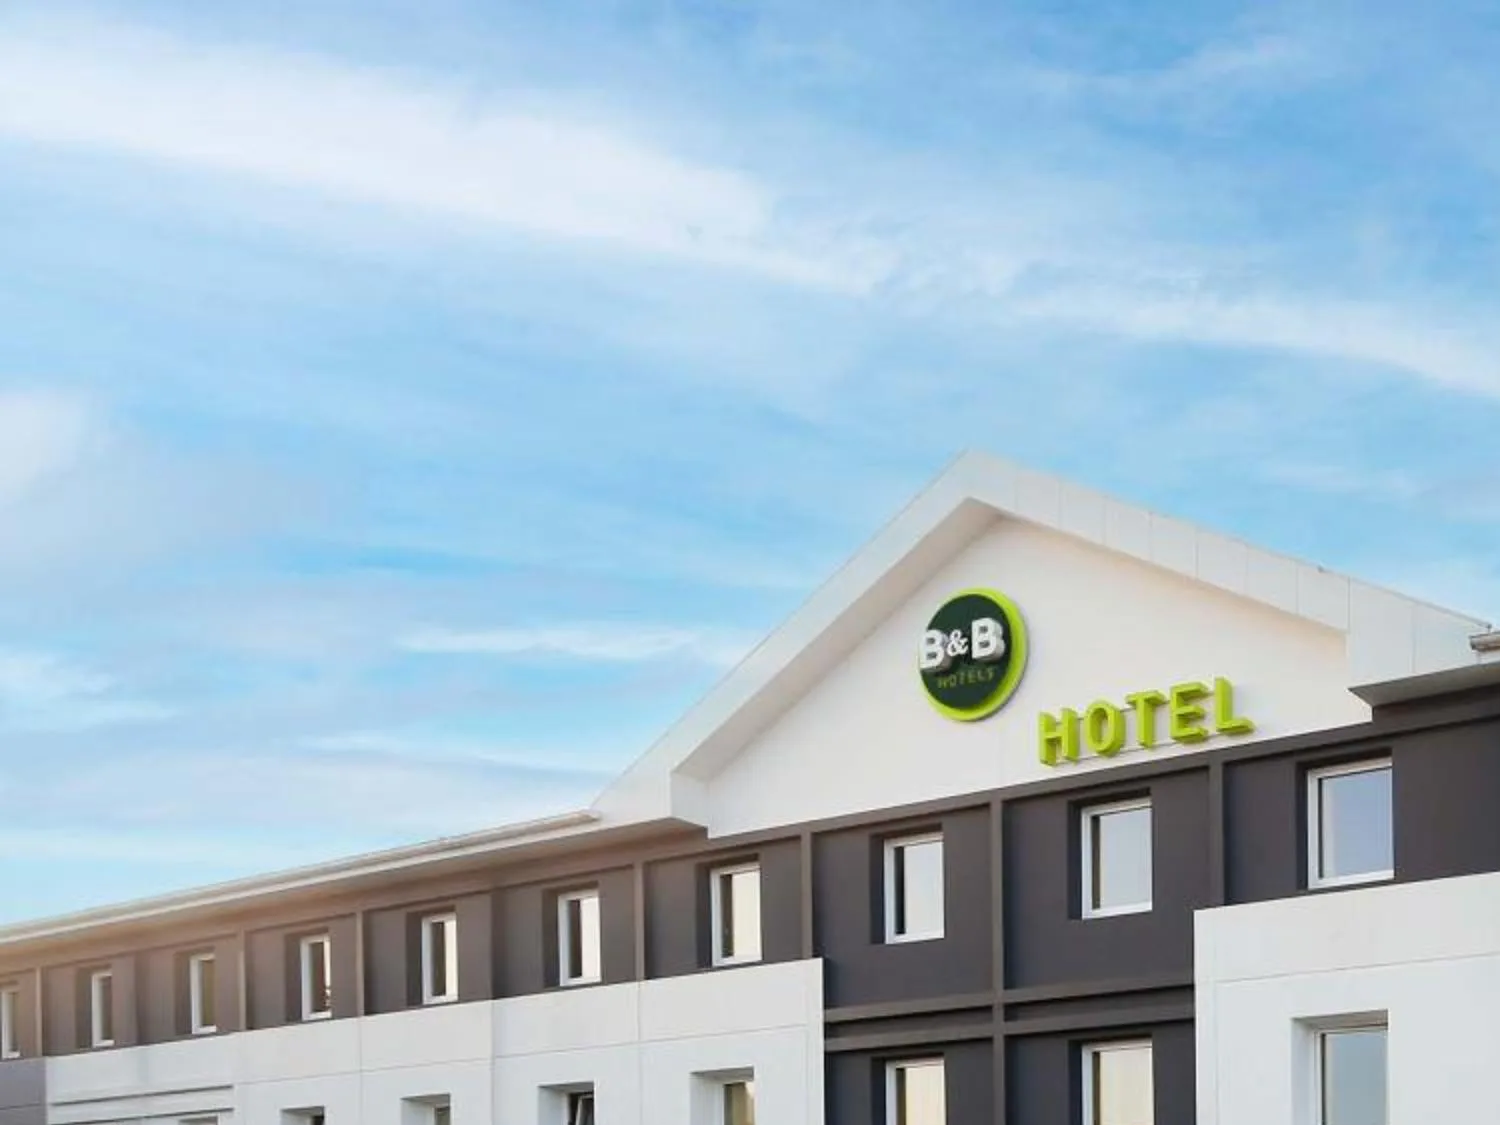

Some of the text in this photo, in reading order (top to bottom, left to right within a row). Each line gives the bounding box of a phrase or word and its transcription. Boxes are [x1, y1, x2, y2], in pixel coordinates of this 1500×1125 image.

[920, 618, 1005, 670] B&B
[937, 667, 995, 689] HOTELS
[1039, 676, 1254, 766] HOTEL
